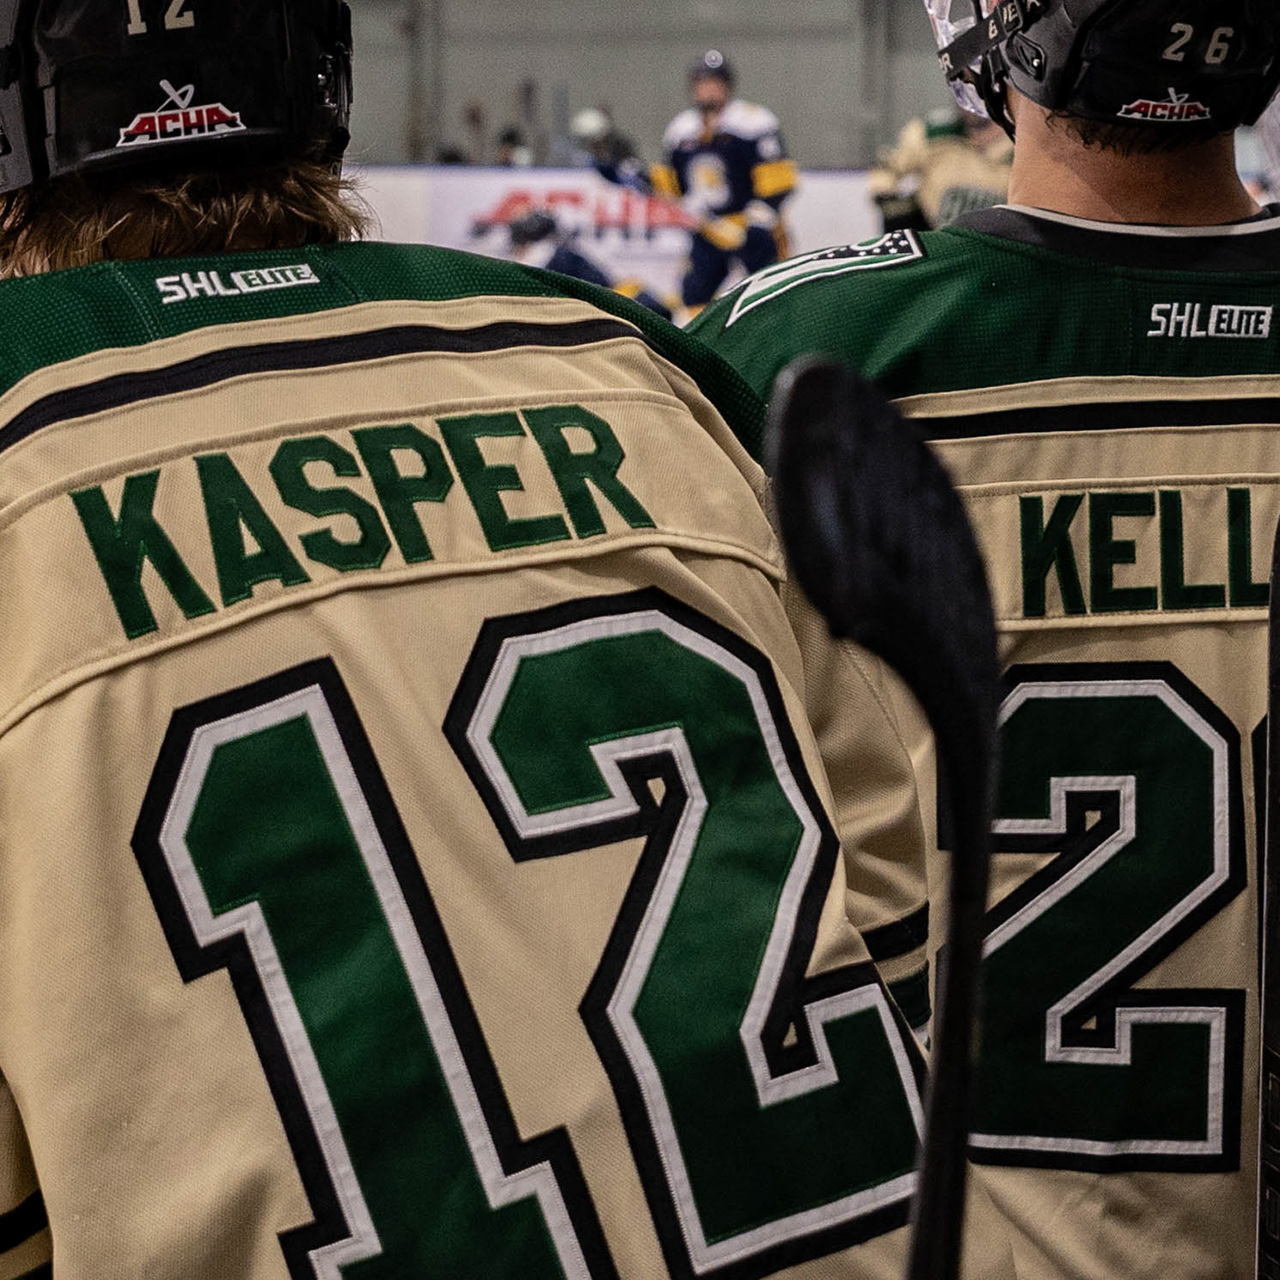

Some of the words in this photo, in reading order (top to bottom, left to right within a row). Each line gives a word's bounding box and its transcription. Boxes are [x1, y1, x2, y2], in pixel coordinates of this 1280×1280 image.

[1162, 22, 1234, 64] 26
[119, 104, 242, 145] ACHA
[1120, 99, 1209, 121] ACHA
[155, 271, 240, 304] SHL
[236, 265, 316, 290] ELITE
[1147, 303, 1207, 337] SHL
[1212, 306, 1270, 337] ELITE
[70, 404, 658, 640] KASPER
[131, 586, 926, 1278] 12
